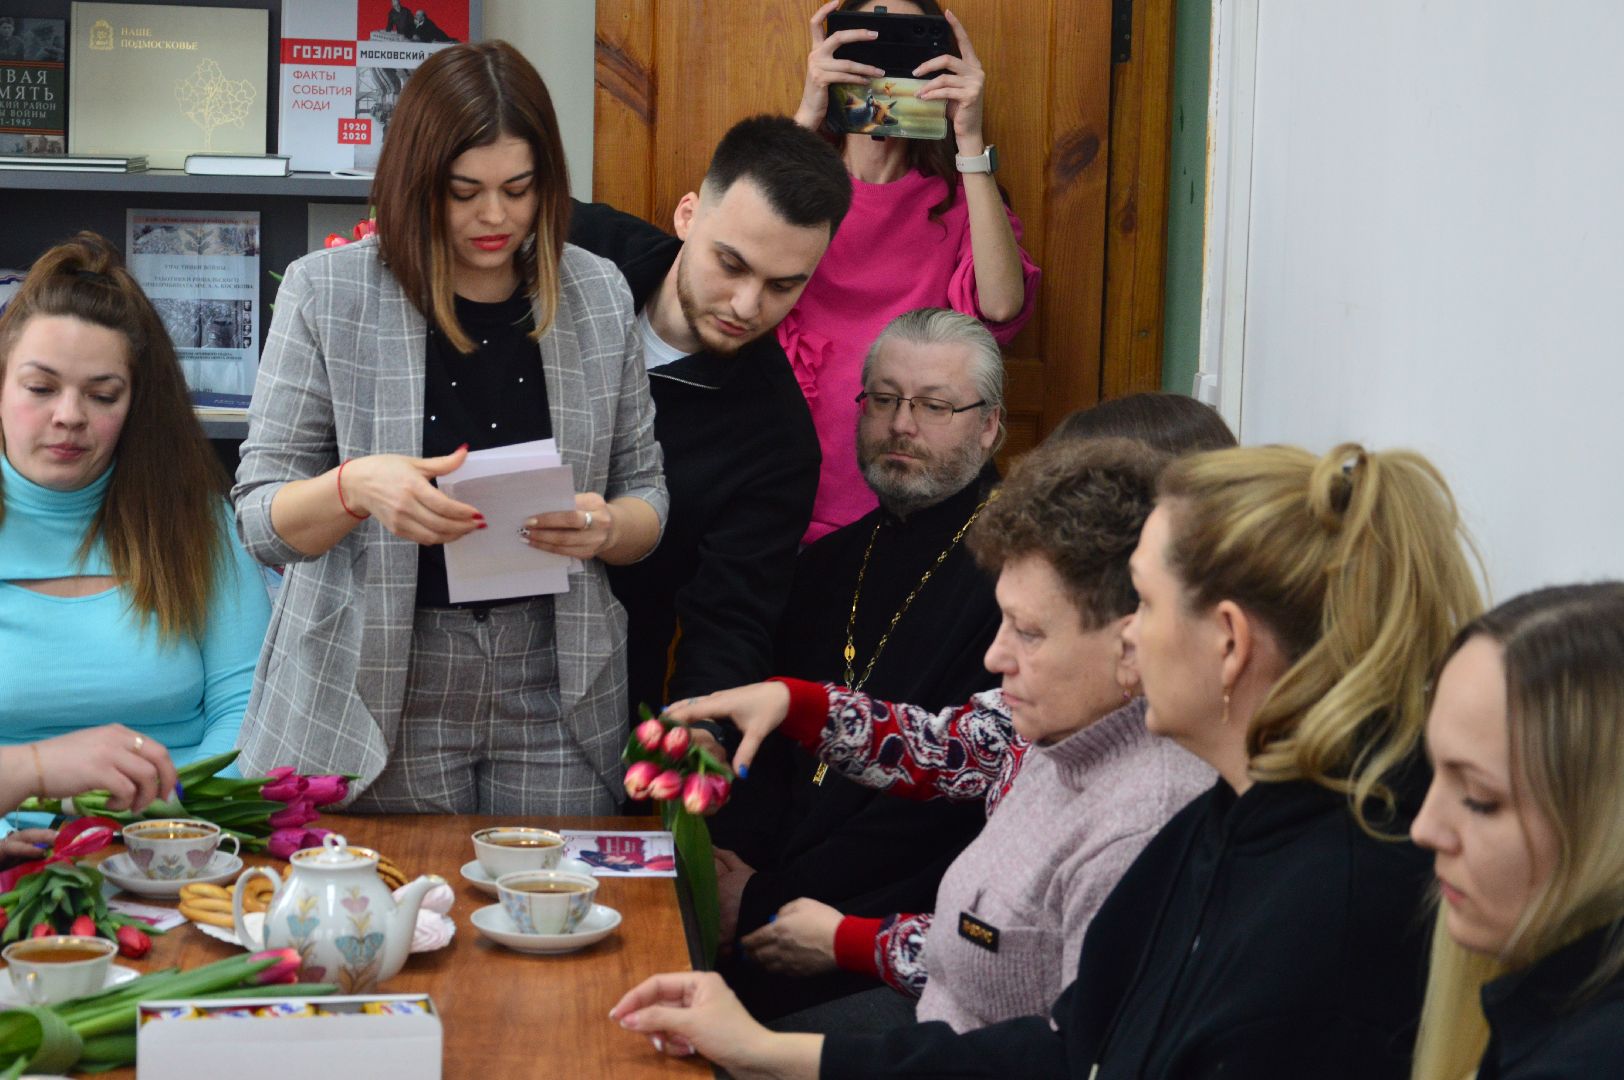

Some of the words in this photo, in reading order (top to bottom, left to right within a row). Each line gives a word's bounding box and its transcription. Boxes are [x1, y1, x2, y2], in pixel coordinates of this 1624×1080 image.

[121, 27, 152, 37] НАШЕ
[121, 39, 199, 50] ПОДМОСКОВЬЕ
[292, 45, 353, 60] ГОЭЛРО
[360, 50, 425, 60] МОСКОВСКИЙ
[0, 69, 47, 84] ВАЯ
[293, 70, 336, 80] ФАКТЫ
[292, 84, 352, 96] СОБЫТИЯ
[23, 101, 56, 111] РАЙОН
[292, 99, 330, 111] ЛЮДИ
[10, 110, 46, 119] ВОЙНЫ
[343, 123, 367, 131] 1920
[342, 132, 367, 140] 2020
